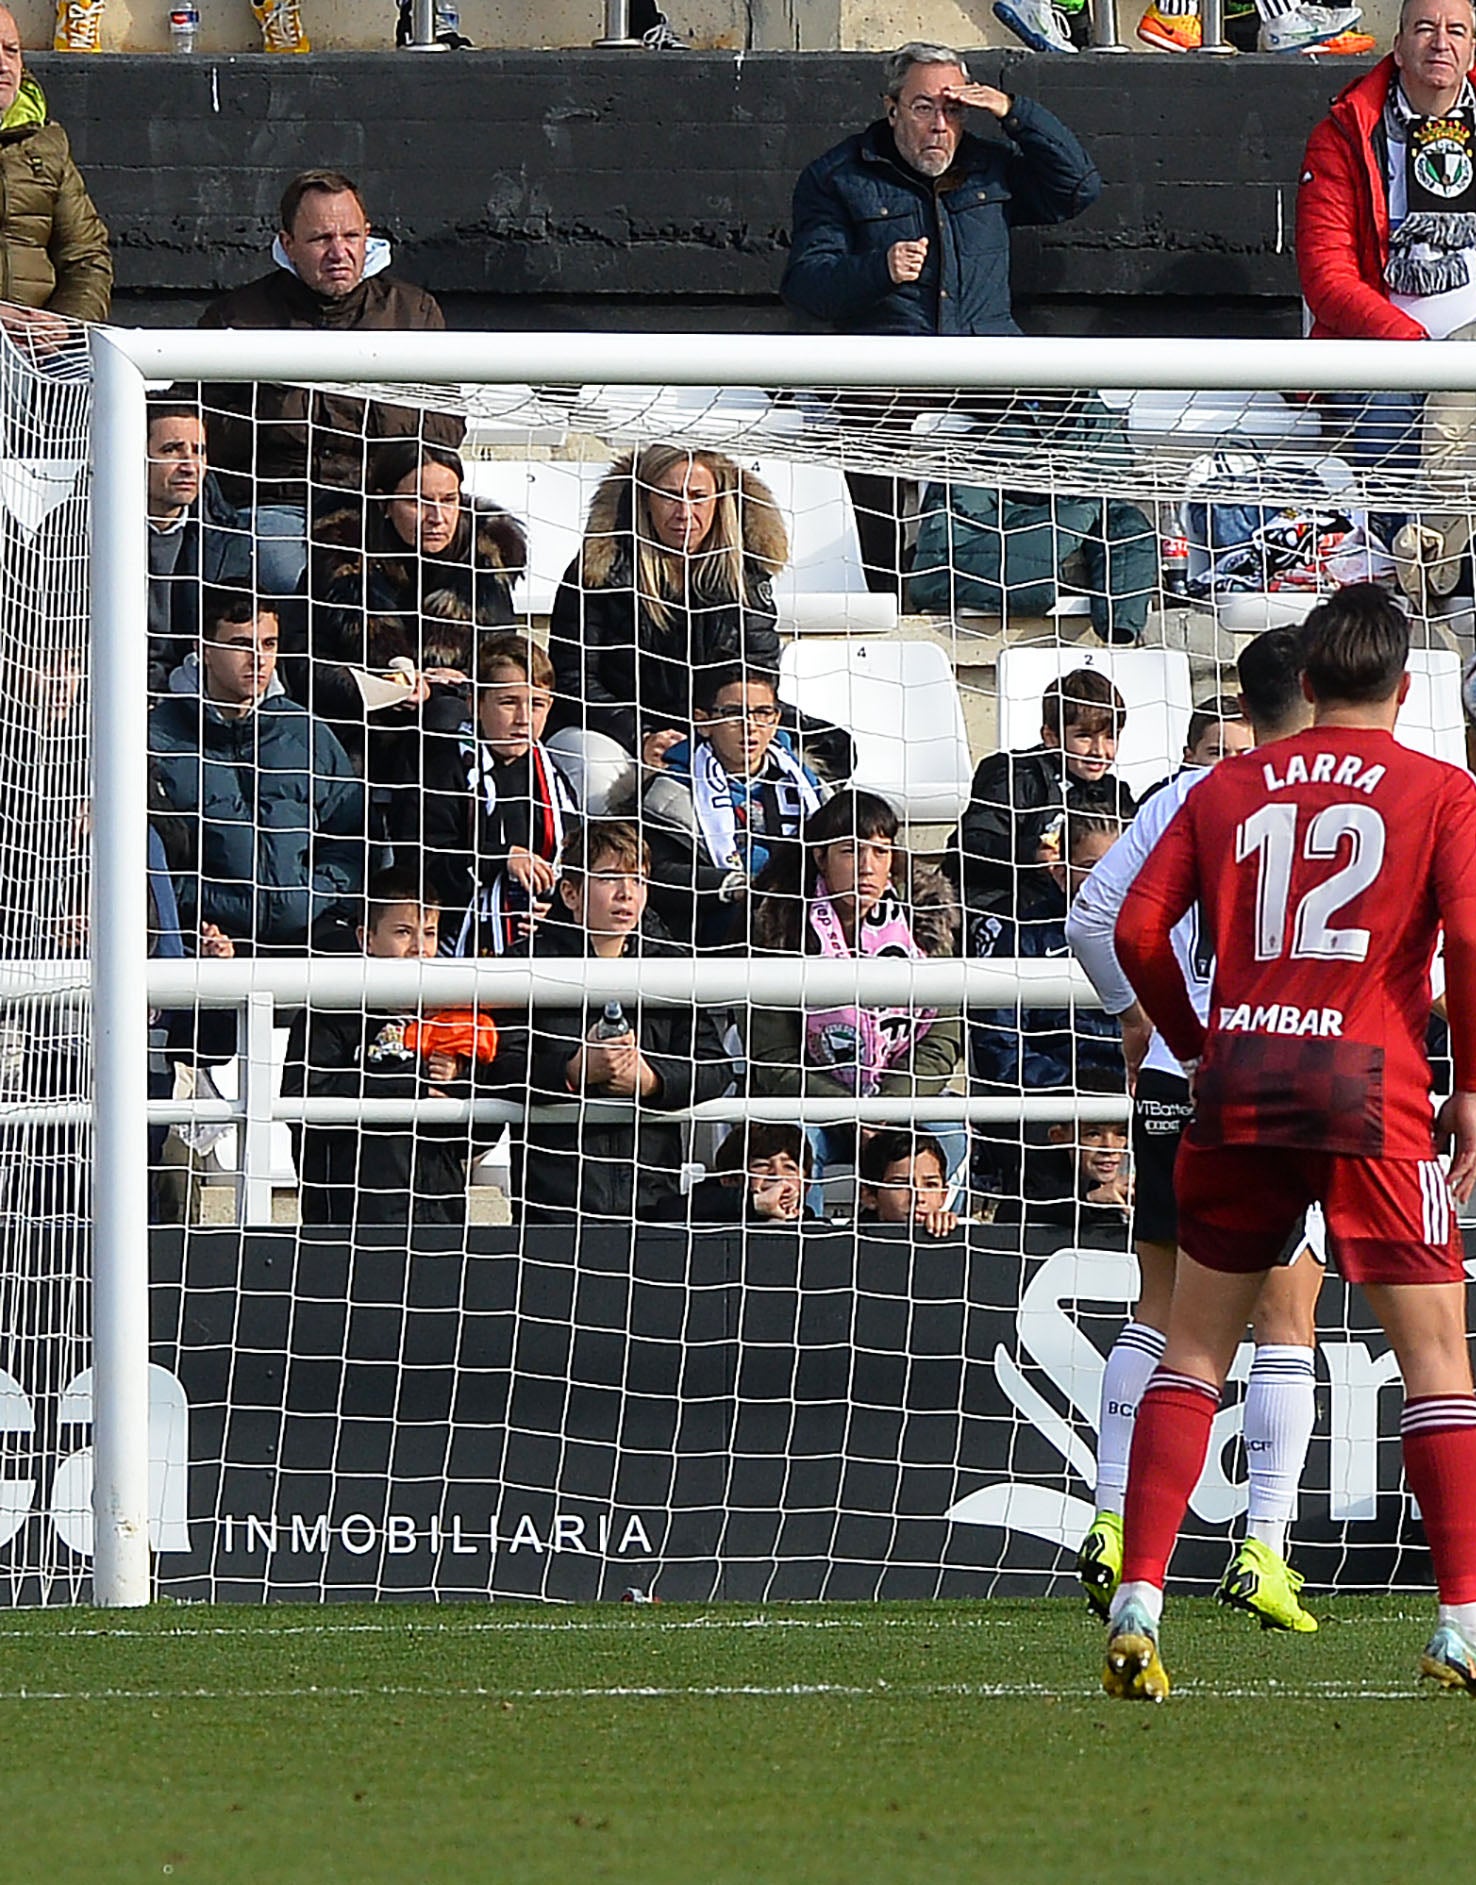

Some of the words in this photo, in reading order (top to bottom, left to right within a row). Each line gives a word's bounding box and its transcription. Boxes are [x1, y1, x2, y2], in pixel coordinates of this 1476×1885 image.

[857, 646, 867, 658] 4
[1084, 654, 1094, 666] 2
[1262, 753, 1386, 794] LARRA
[1236, 803, 1385, 962] 12
[1226, 1003, 1344, 1037] AMBAR
[1108, 1401, 1138, 1419] BC
[222, 1513, 653, 1555] INMOBILIARIA
